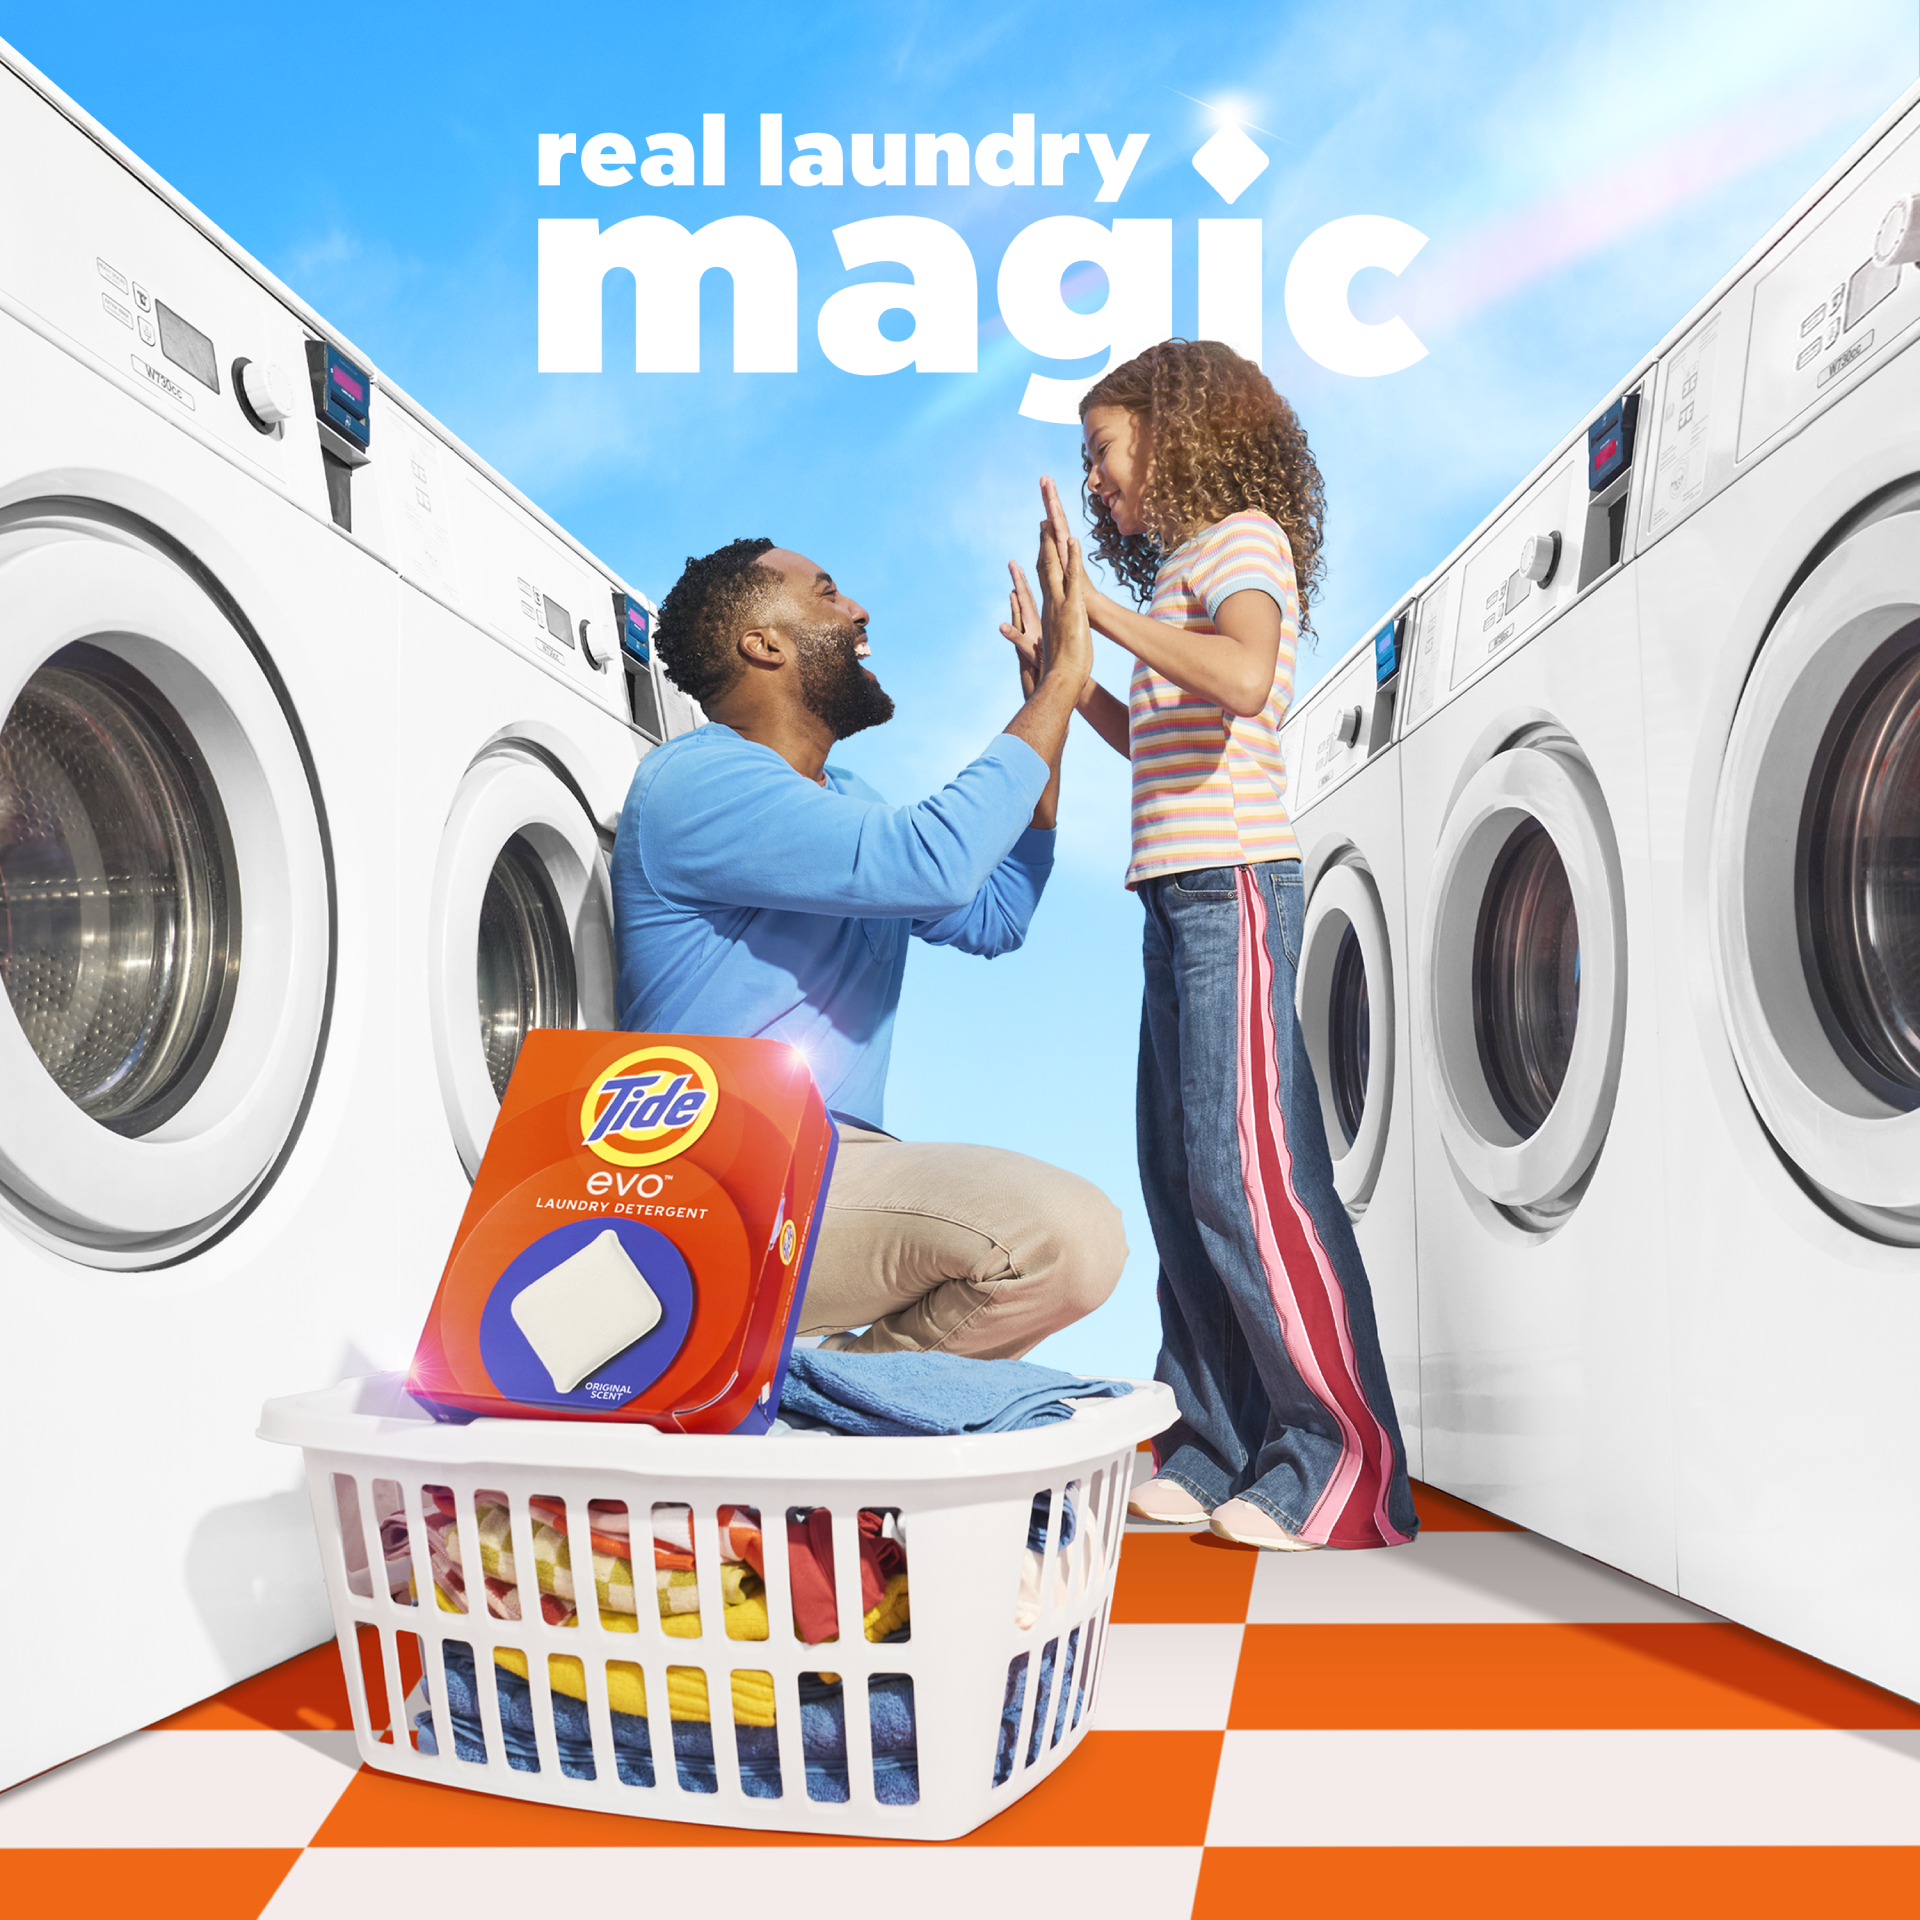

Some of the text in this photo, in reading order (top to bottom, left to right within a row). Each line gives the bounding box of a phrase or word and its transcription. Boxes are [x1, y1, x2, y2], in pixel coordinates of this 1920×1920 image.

[145, 363, 183, 399] W730cc
[581, 1073, 710, 1146] Tide
[535, 1197, 708, 1220] LAUNDRY DETERGENT
[584, 1381, 632, 1394] ORIGINAL
[590, 1390, 624, 1401] SCENT
